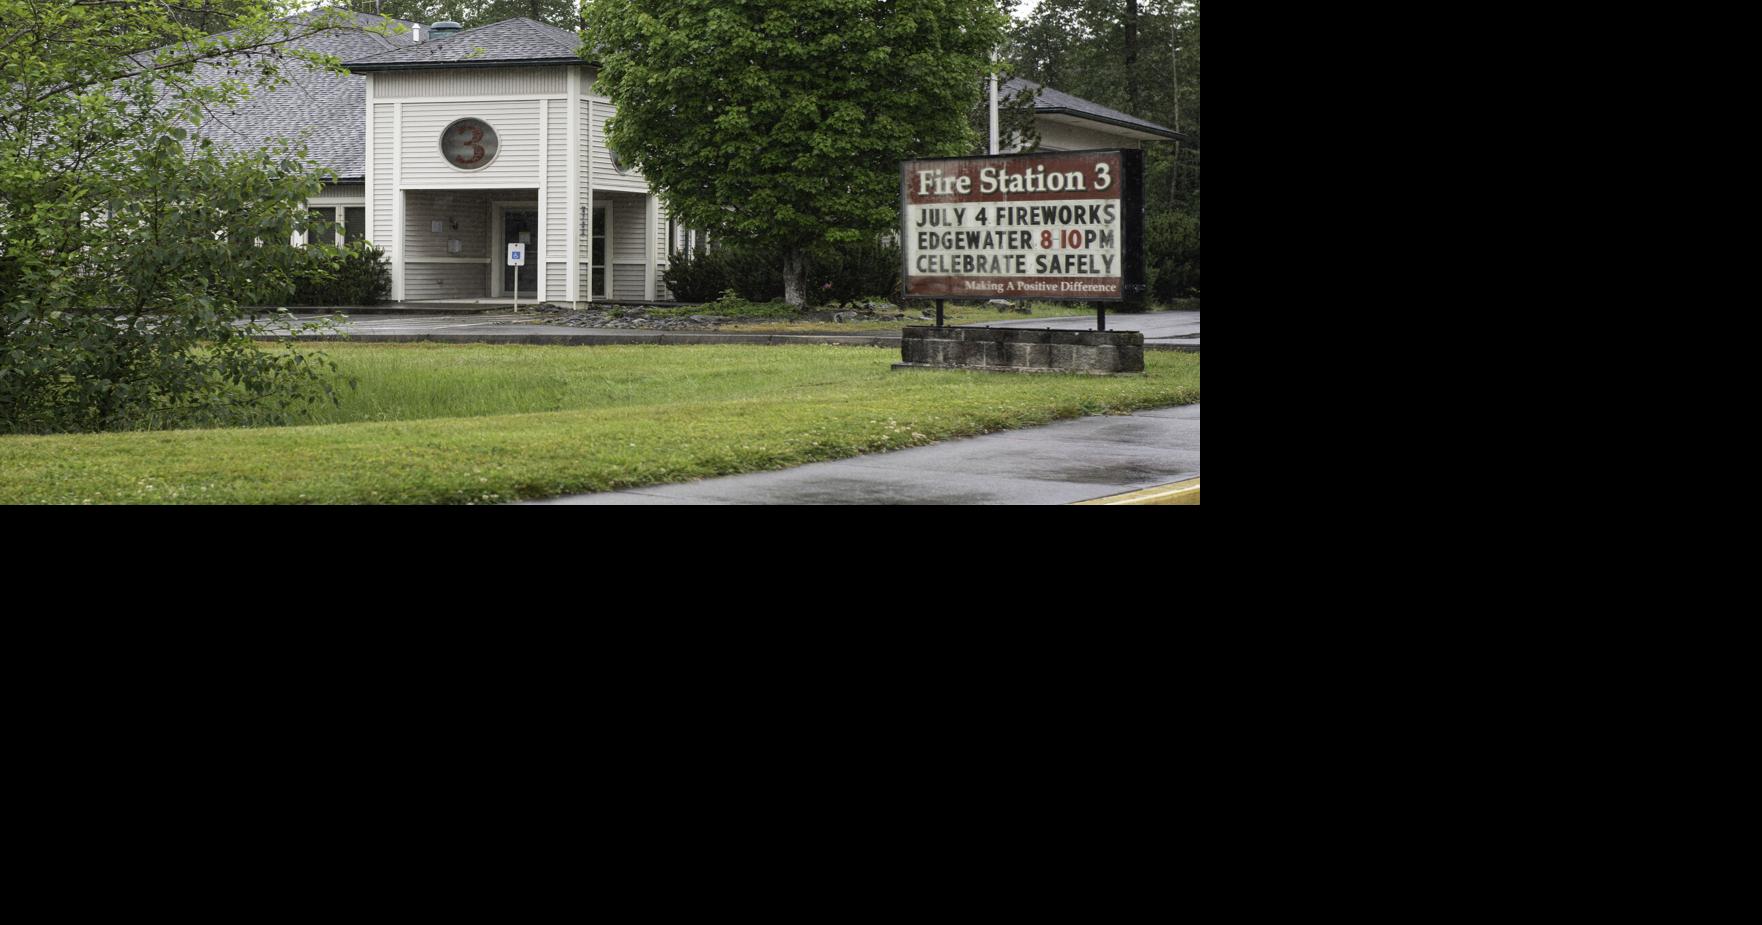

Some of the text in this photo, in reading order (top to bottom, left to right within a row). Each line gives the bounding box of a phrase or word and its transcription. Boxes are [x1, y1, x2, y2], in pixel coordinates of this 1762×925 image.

[456, 126, 485, 164] 3
[917, 162, 1111, 196] Fire Station 3
[916, 204, 1116, 227] JULY 4 FIREWORKS
[918, 231, 1032, 250] EDGEWATER
[916, 254, 1115, 274] CELEBRATE SAFELY
[965, 281, 1116, 293] Making A Positive Difference
